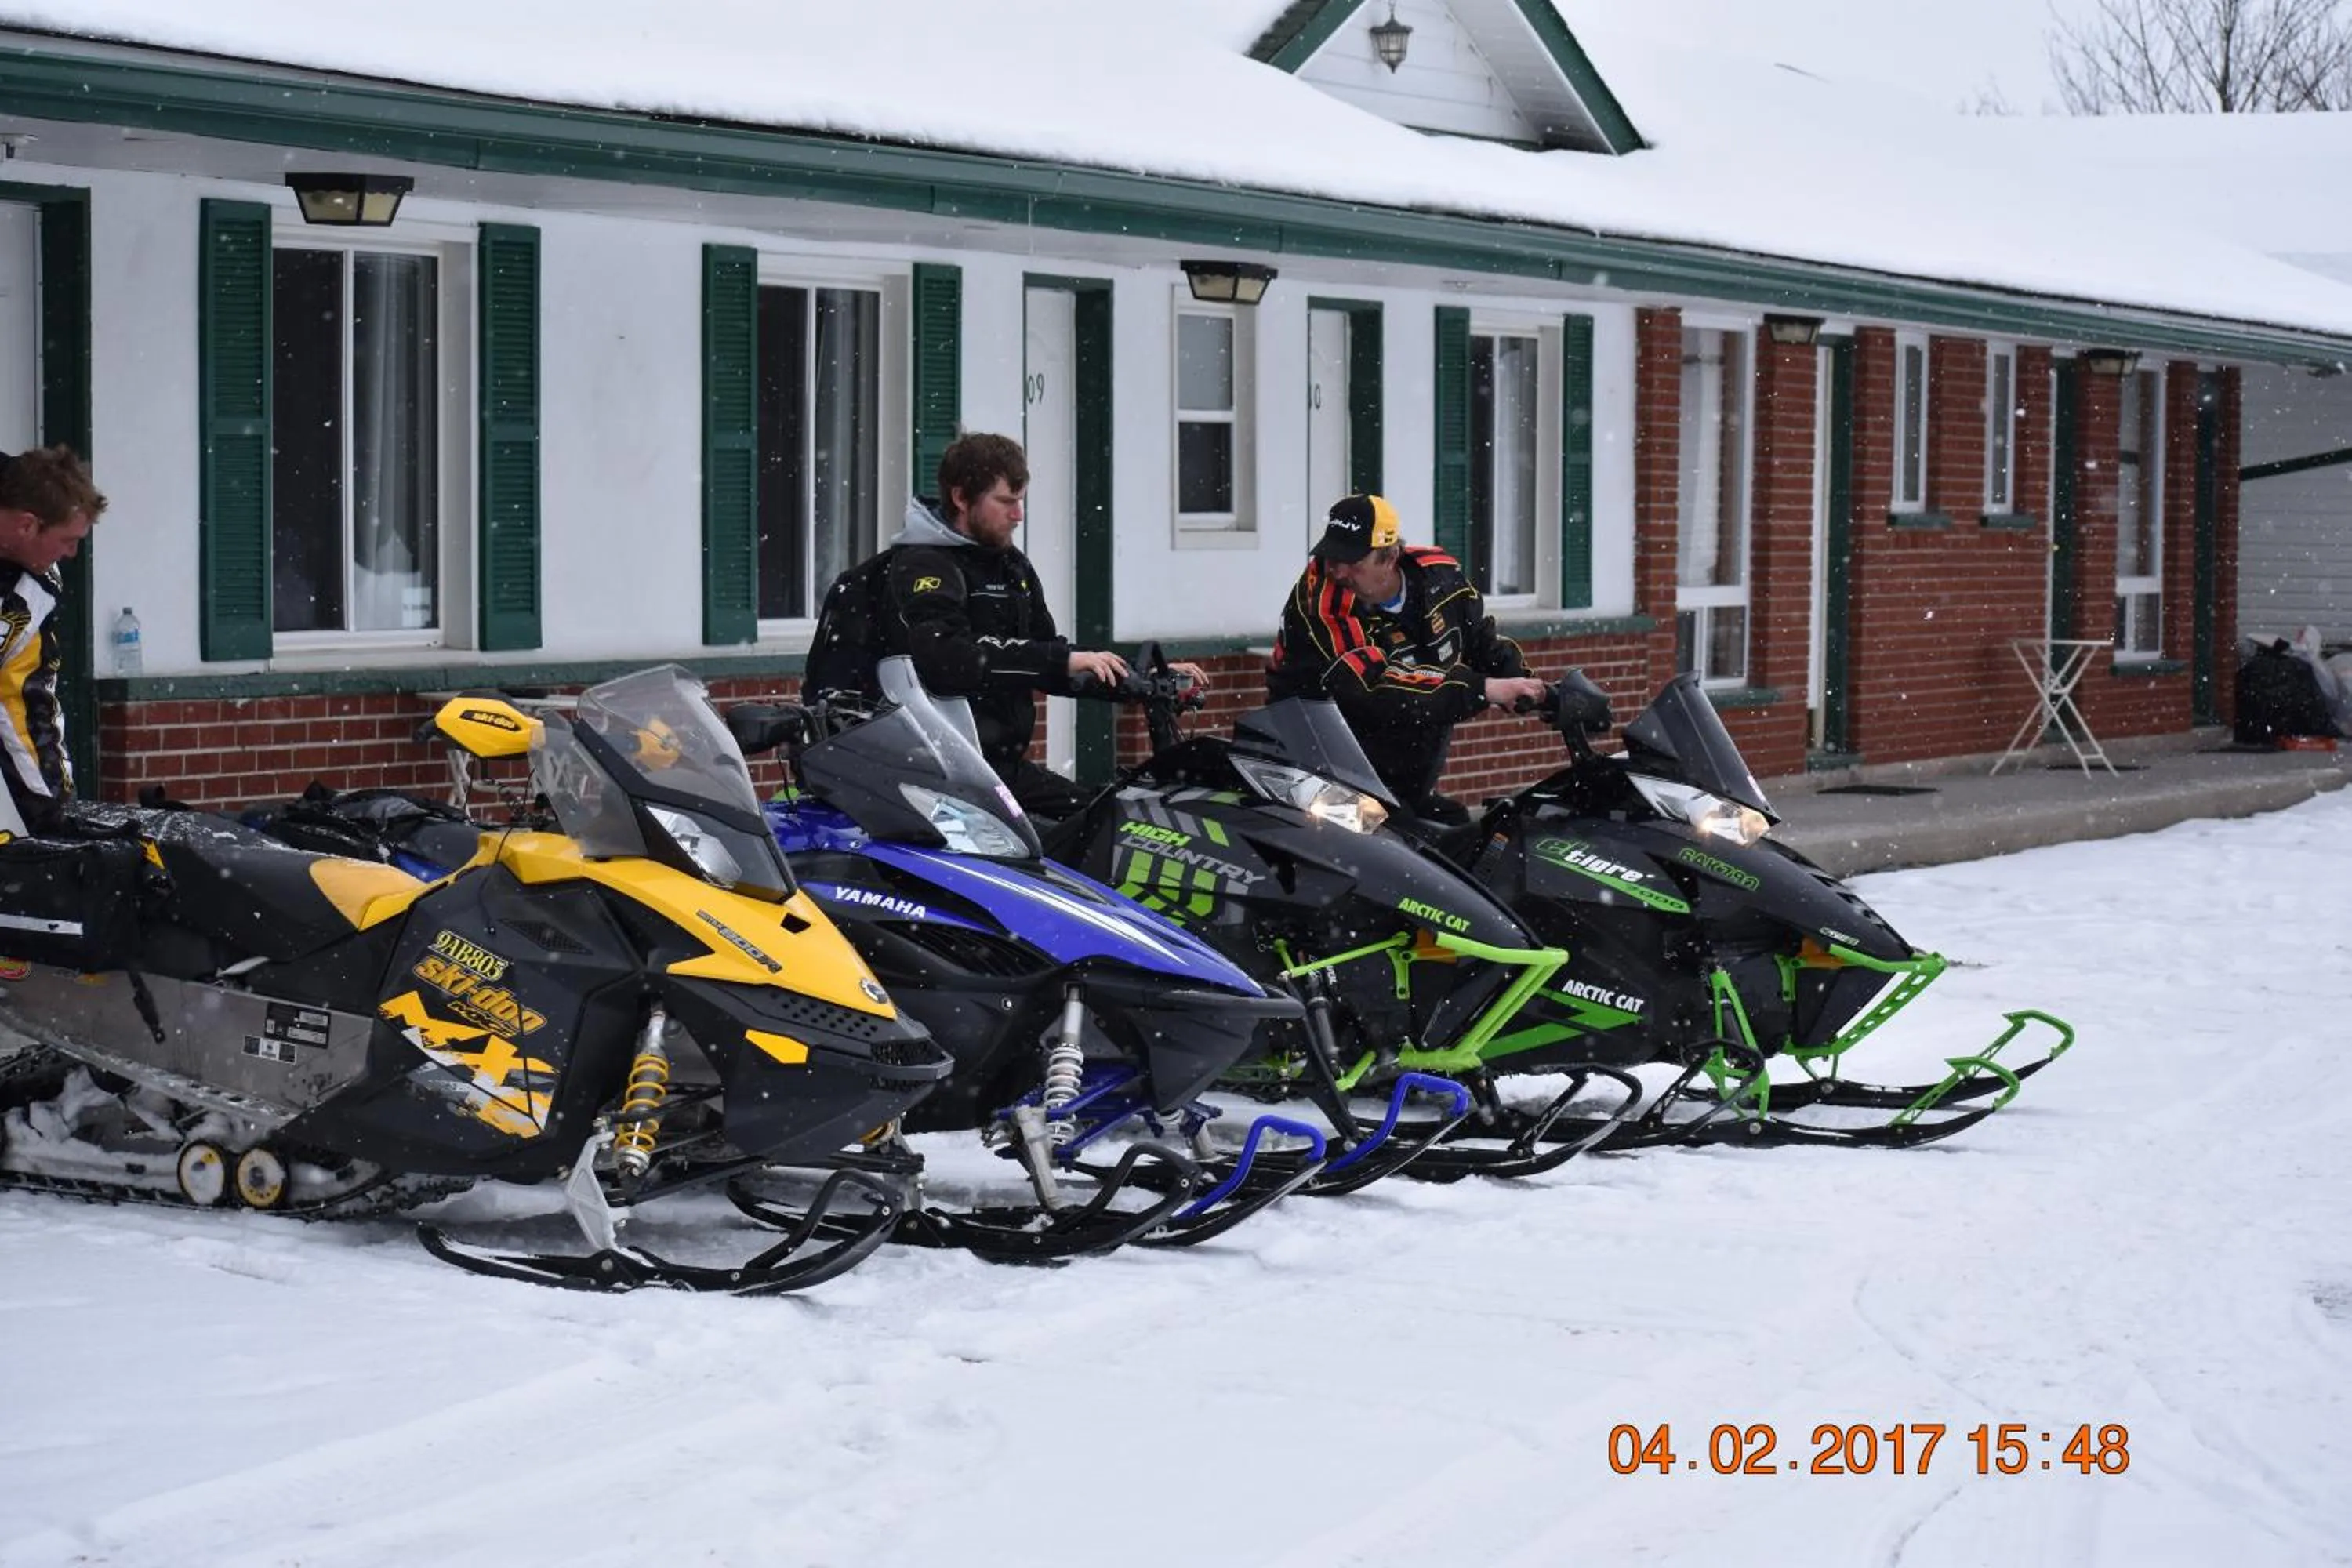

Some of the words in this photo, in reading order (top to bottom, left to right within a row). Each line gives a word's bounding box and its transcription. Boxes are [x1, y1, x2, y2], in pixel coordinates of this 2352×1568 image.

[1119, 820, 1192, 848] HIGH
[1120, 834, 1267, 885] COUNTRY
[833, 886, 927, 920] YAMAHA
[1398, 897, 1445, 924] ARCTIC
[1444, 916, 1472, 933] CAT
[434, 931, 506, 978] 9AB805
[413, 956, 547, 1035] ski-doo
[1563, 979, 1614, 1007] ARCTIC
[1614, 993, 1645, 1014] CAT
